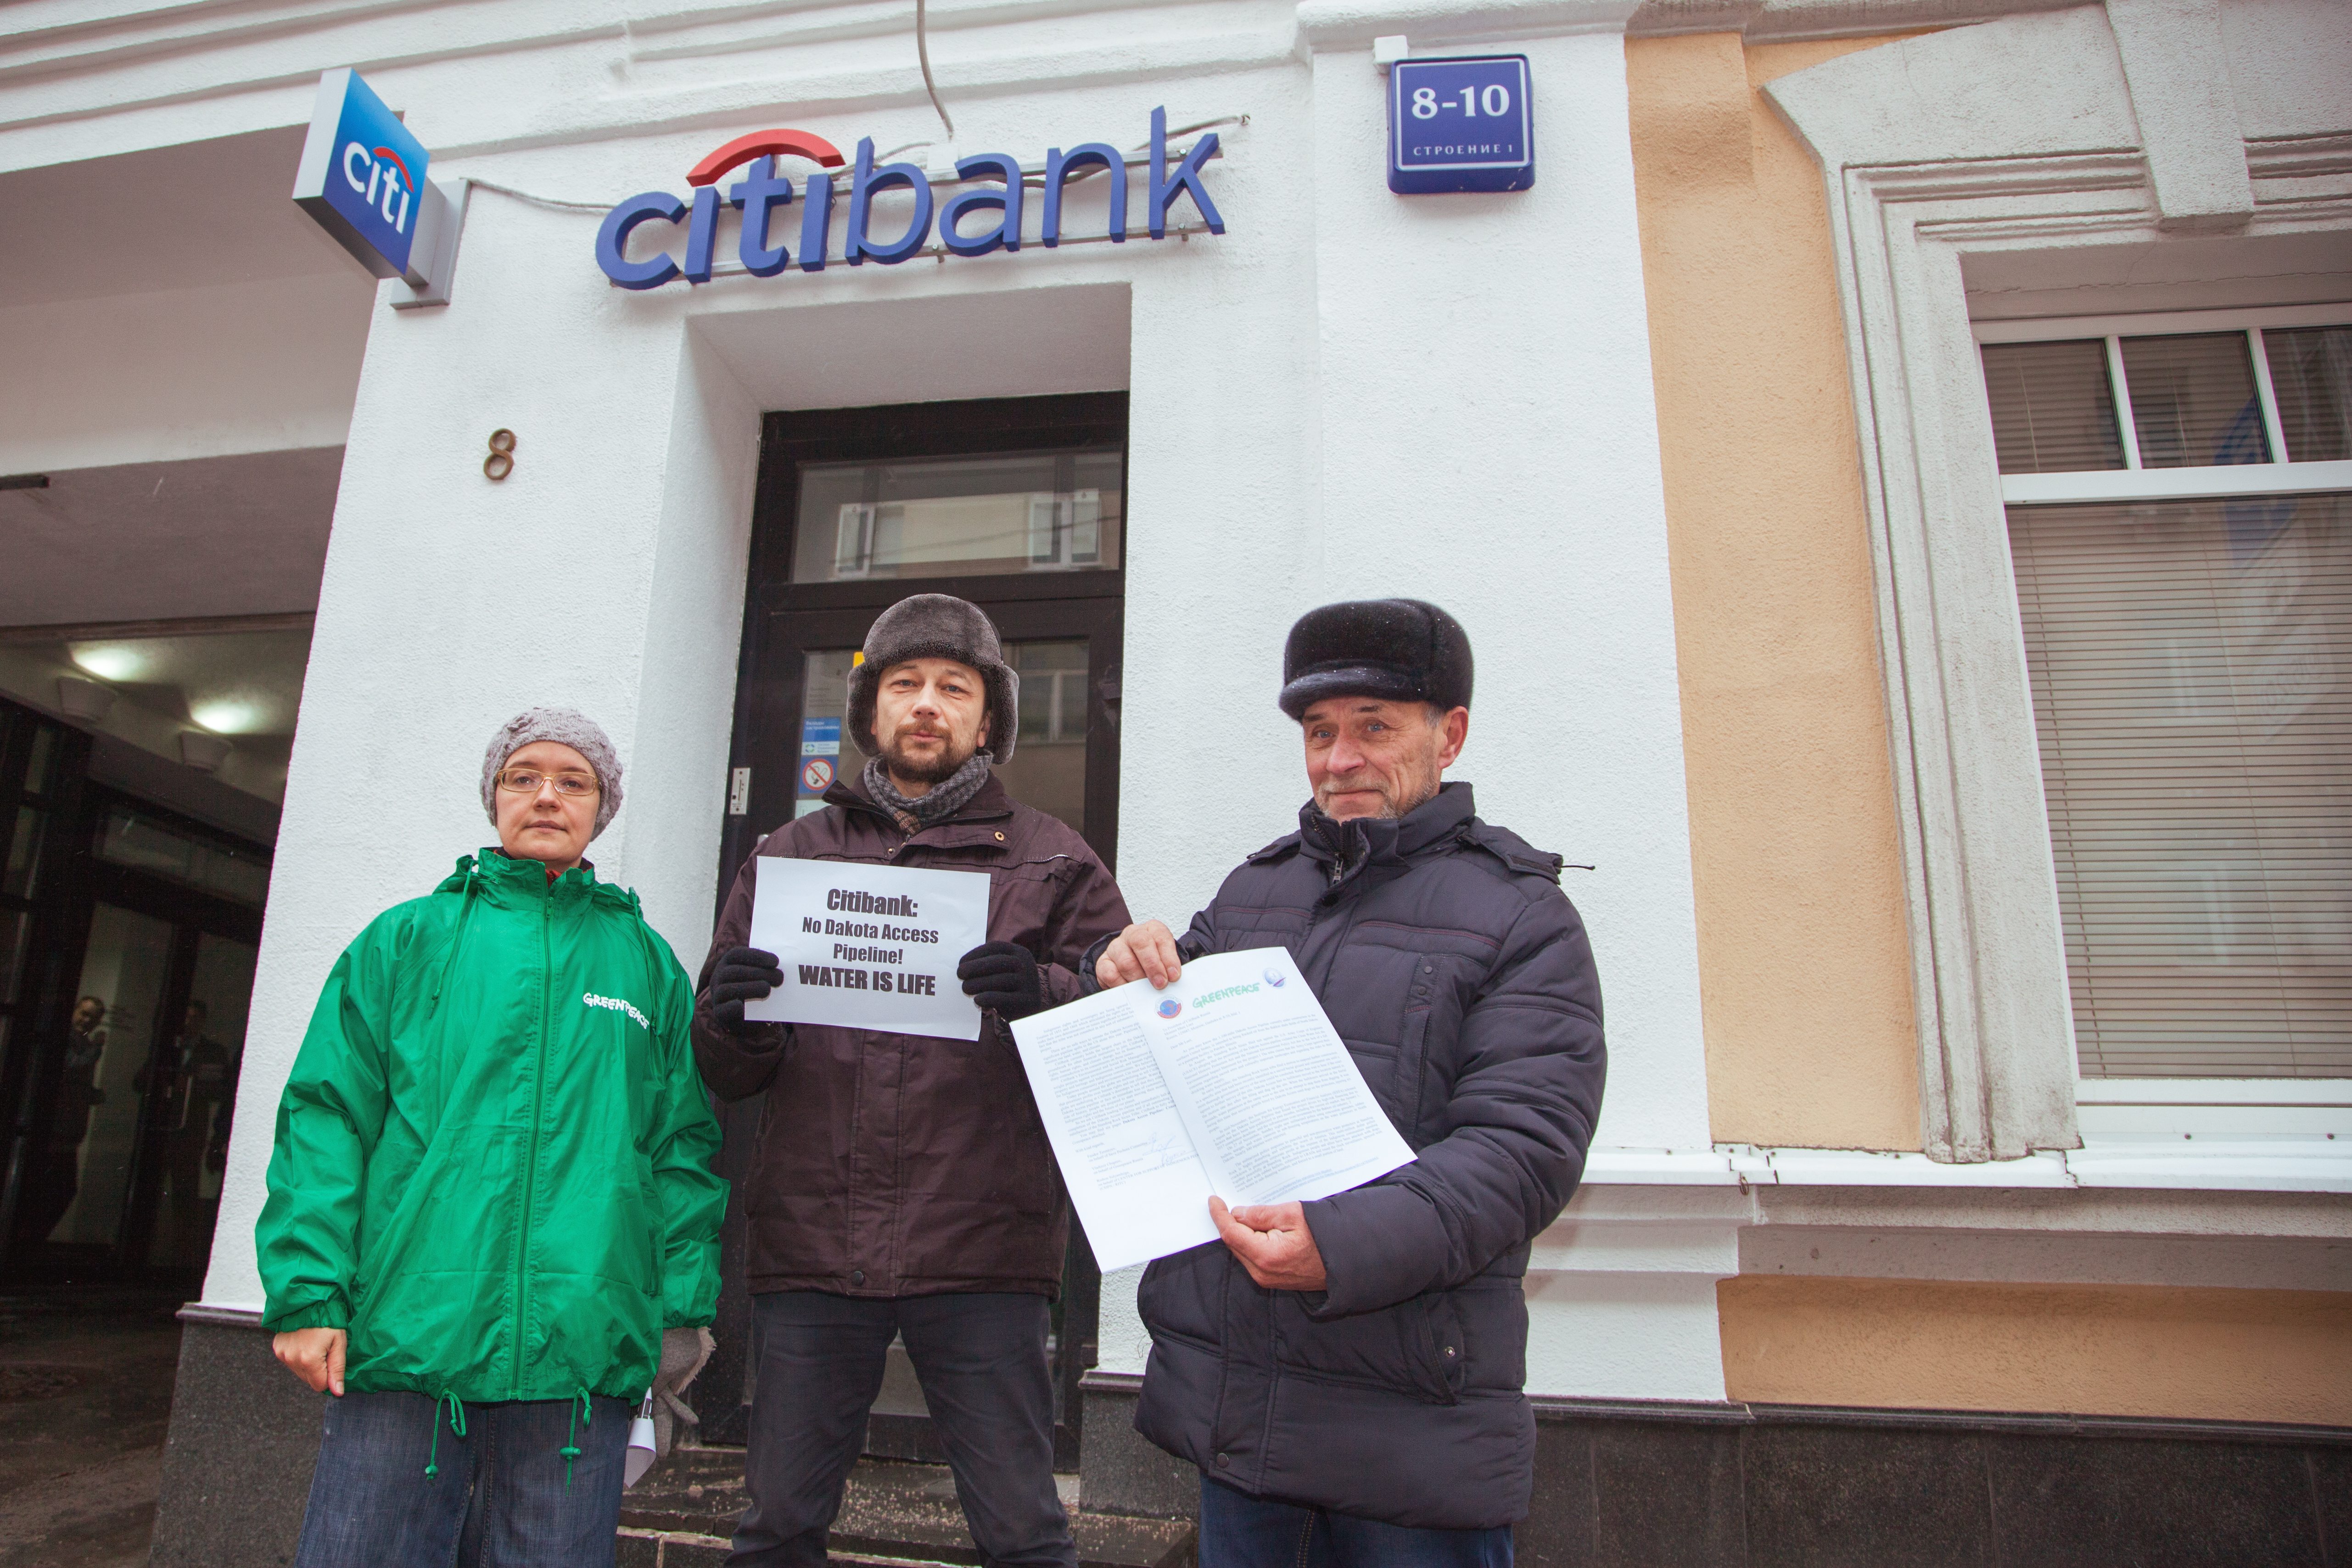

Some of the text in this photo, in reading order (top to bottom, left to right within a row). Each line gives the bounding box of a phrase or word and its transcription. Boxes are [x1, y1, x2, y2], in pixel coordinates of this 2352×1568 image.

[1411, 84, 1510, 119] 8-10
[1413, 144, 1501, 156] СТРОЕНИЕ
[343, 141, 410, 234] citi
[595, 105, 1225, 290] citibank
[483, 428, 516, 480] 8
[827, 888, 918, 917] Citibank:
[802, 916, 939, 944] No Dakota Access
[833, 943, 903, 964] Pipeline!
[799, 964, 935, 996] WATER IS LIFE
[1192, 982, 1260, 1008] GREENPEACE
[582, 992, 650, 1030] GREENPEACE
